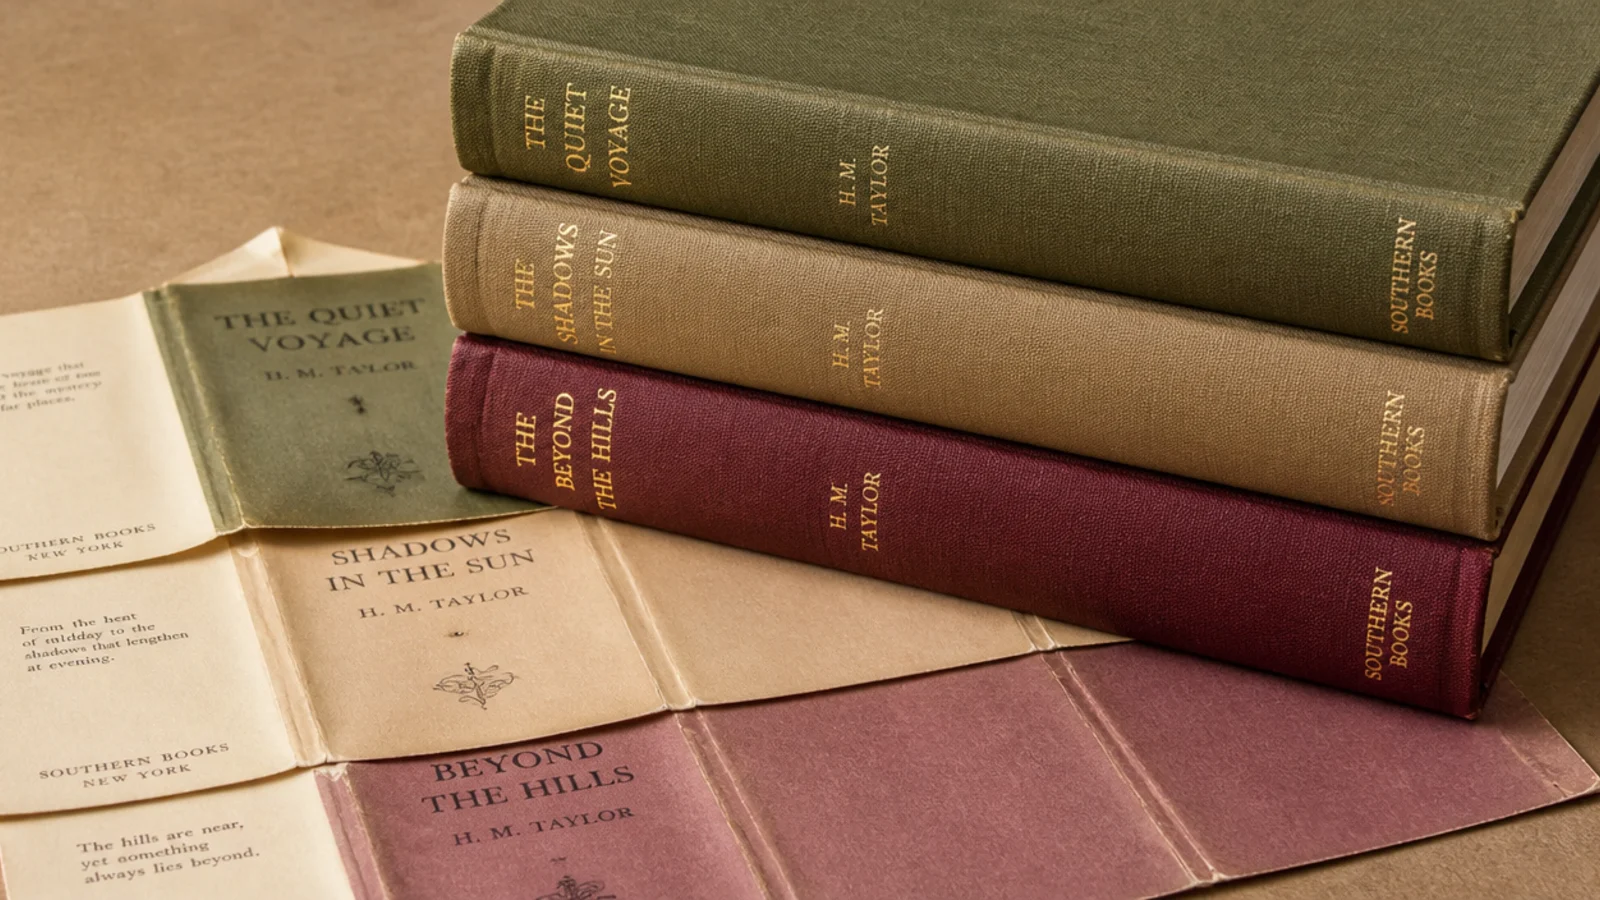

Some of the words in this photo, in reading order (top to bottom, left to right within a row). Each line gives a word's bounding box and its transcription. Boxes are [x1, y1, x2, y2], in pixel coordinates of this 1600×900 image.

[525, 95, 546, 151] THE
[564, 83, 591, 173] QUIET
[608, 86, 631, 188] VOYAGE
[839, 158, 857, 181] M.
[870, 145, 889, 226] TAYLOR
[839, 186, 857, 207] H.
[594, 229, 618, 279] SUN
[515, 258, 535, 310] THE
[552, 222, 578, 344] SHADOWS
[1391, 217, 1417, 334] SOUTHERN
[1416, 250, 1438, 320] BOOKS
[214, 310, 296, 330] THE
[309, 298, 425, 326] QUIET
[593, 285, 613, 331] THE
[249, 326, 415, 352] VOYAGE
[596, 333, 617, 354] IN
[833, 321, 851, 343] M.
[863, 308, 884, 388] TAYLOR
[330, 361, 418, 377] TAYLOR
[832, 347, 849, 369] H.
[516, 412, 537, 467] THE
[552, 392, 575, 491] BEYOND
[592, 387, 617, 464] HILLS
[1377, 390, 1405, 507] SOUTHERN
[1402, 426, 1425, 497] BOOKS
[592, 467, 617, 510] THE
[829, 482, 848, 506] M.
[829, 512, 847, 530] H.
[861, 472, 881, 552] TAYLOR
[0, 536, 84, 553] OUTHERN
[94, 523, 156, 540] BOOKS
[76, 541, 124, 554] YORK
[331, 529, 512, 566] SHADOWS
[326, 573, 366, 592] IN
[378, 562, 455, 586] THE
[467, 549, 536, 574] SUN
[360, 607, 385, 619] H.
[395, 602, 422, 614] M.
[430, 586, 529, 609] TAYLOR
[20, 624, 64, 635] From
[72, 619, 96, 629] the
[22, 638, 39, 647] of
[110, 628, 125, 636] to
[131, 623, 155, 633] the
[1364, 567, 1393, 681] SOUTHERN
[1389, 600, 1413, 668] BOOKS
[25, 646, 87, 660] shadows
[92, 641, 121, 651] that
[126, 632, 189, 646] lengthen
[27, 664, 42, 673] at
[49, 655, 115, 670] evening.
[39, 756, 151, 780] SOUTHERN
[162, 743, 230, 763] BOOKS
[83, 774, 128, 788] NEW
[137, 764, 191, 780] YORK
[430, 741, 604, 782] BEYOND
[421, 786, 513, 814] THE
[522, 765, 635, 800] HILLS
[76, 841, 113, 853] The
[121, 834, 159, 847] hills
[166, 829, 194, 841] are
[201, 821, 244, 834] near,
[454, 832, 481, 847] H.
[491, 825, 521, 840] M.
[530, 807, 635, 833] TAYLOR
[80, 857, 108, 871] yet
[85, 868, 145, 884] always
[153, 862, 183, 874] lies
[191, 847, 260, 867] beyond.
